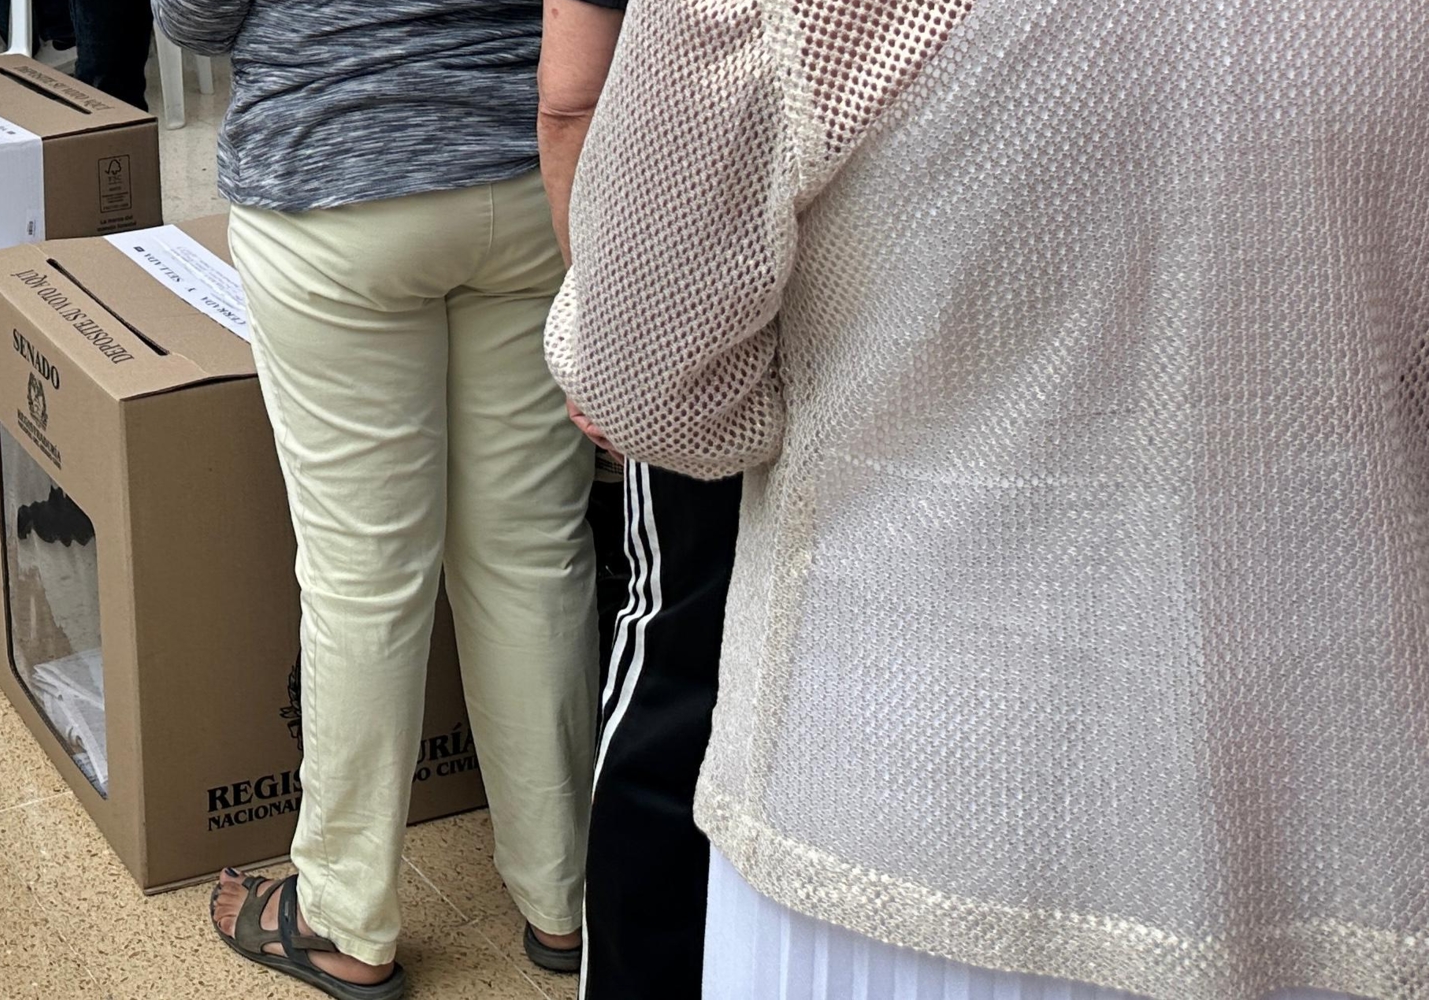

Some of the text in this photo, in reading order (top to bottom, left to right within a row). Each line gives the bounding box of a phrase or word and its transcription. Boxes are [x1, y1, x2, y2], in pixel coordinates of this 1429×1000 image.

[10, 269, 135, 365] DEPOSITE SU VOTO AQUÍ
[13, 328, 60, 390] SENADO
